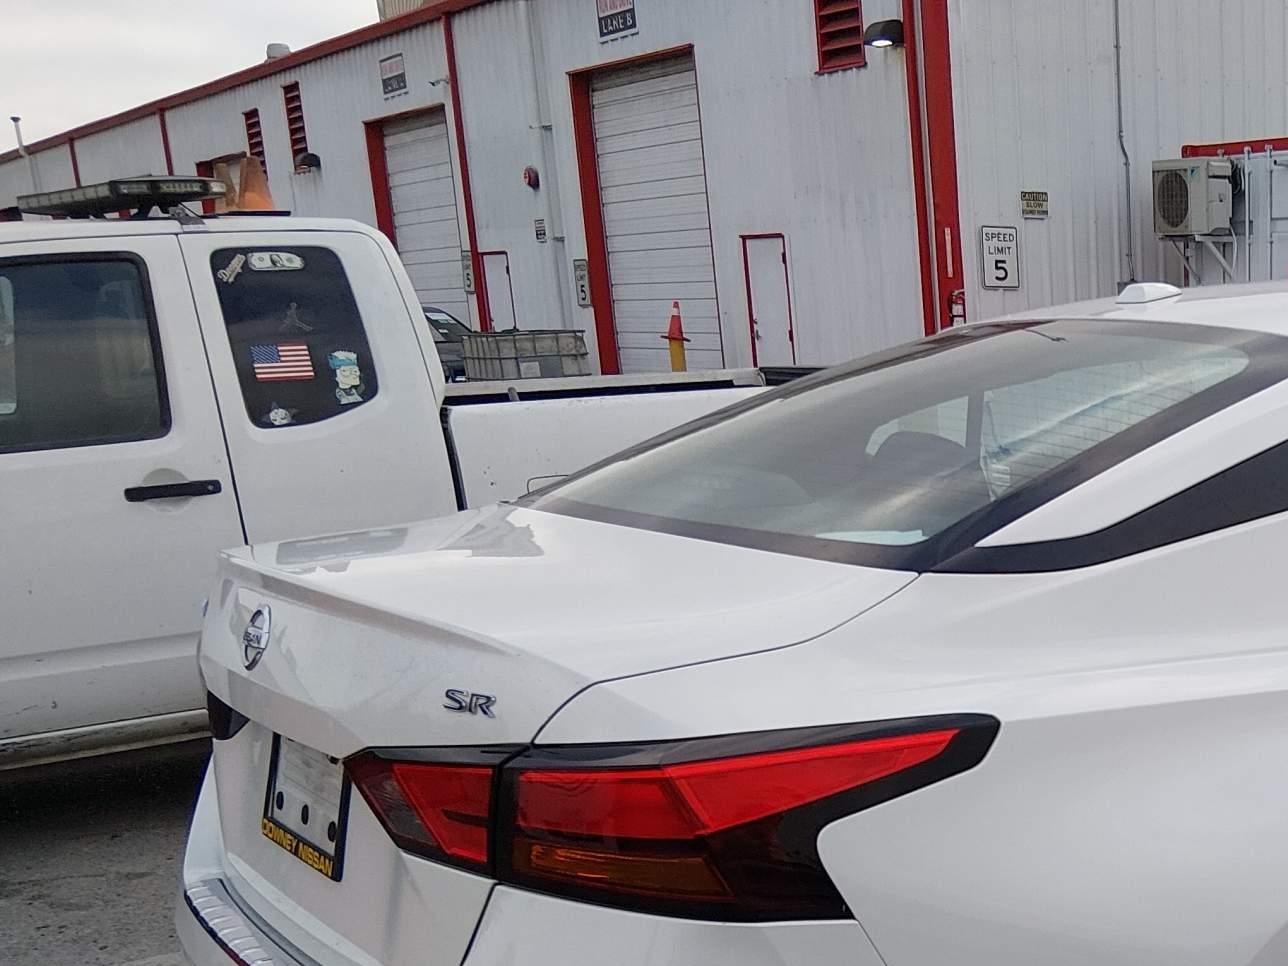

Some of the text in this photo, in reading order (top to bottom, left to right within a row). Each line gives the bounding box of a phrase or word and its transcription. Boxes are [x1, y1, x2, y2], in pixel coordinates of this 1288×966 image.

[602, 15, 624, 33] LANE
[1021, 192, 1047, 201] CAUTION
[1026, 201, 1044, 209] SLOW
[985, 232, 1015, 242] SPEED
[988, 246, 1012, 255] LIMIT
[994, 259, 1009, 281] 5
[465, 272, 472, 288] 5
[580, 284, 587, 301] 5
[442, 689, 496, 718] SR
[262, 819, 334, 876] DOWNEY NISSAN
